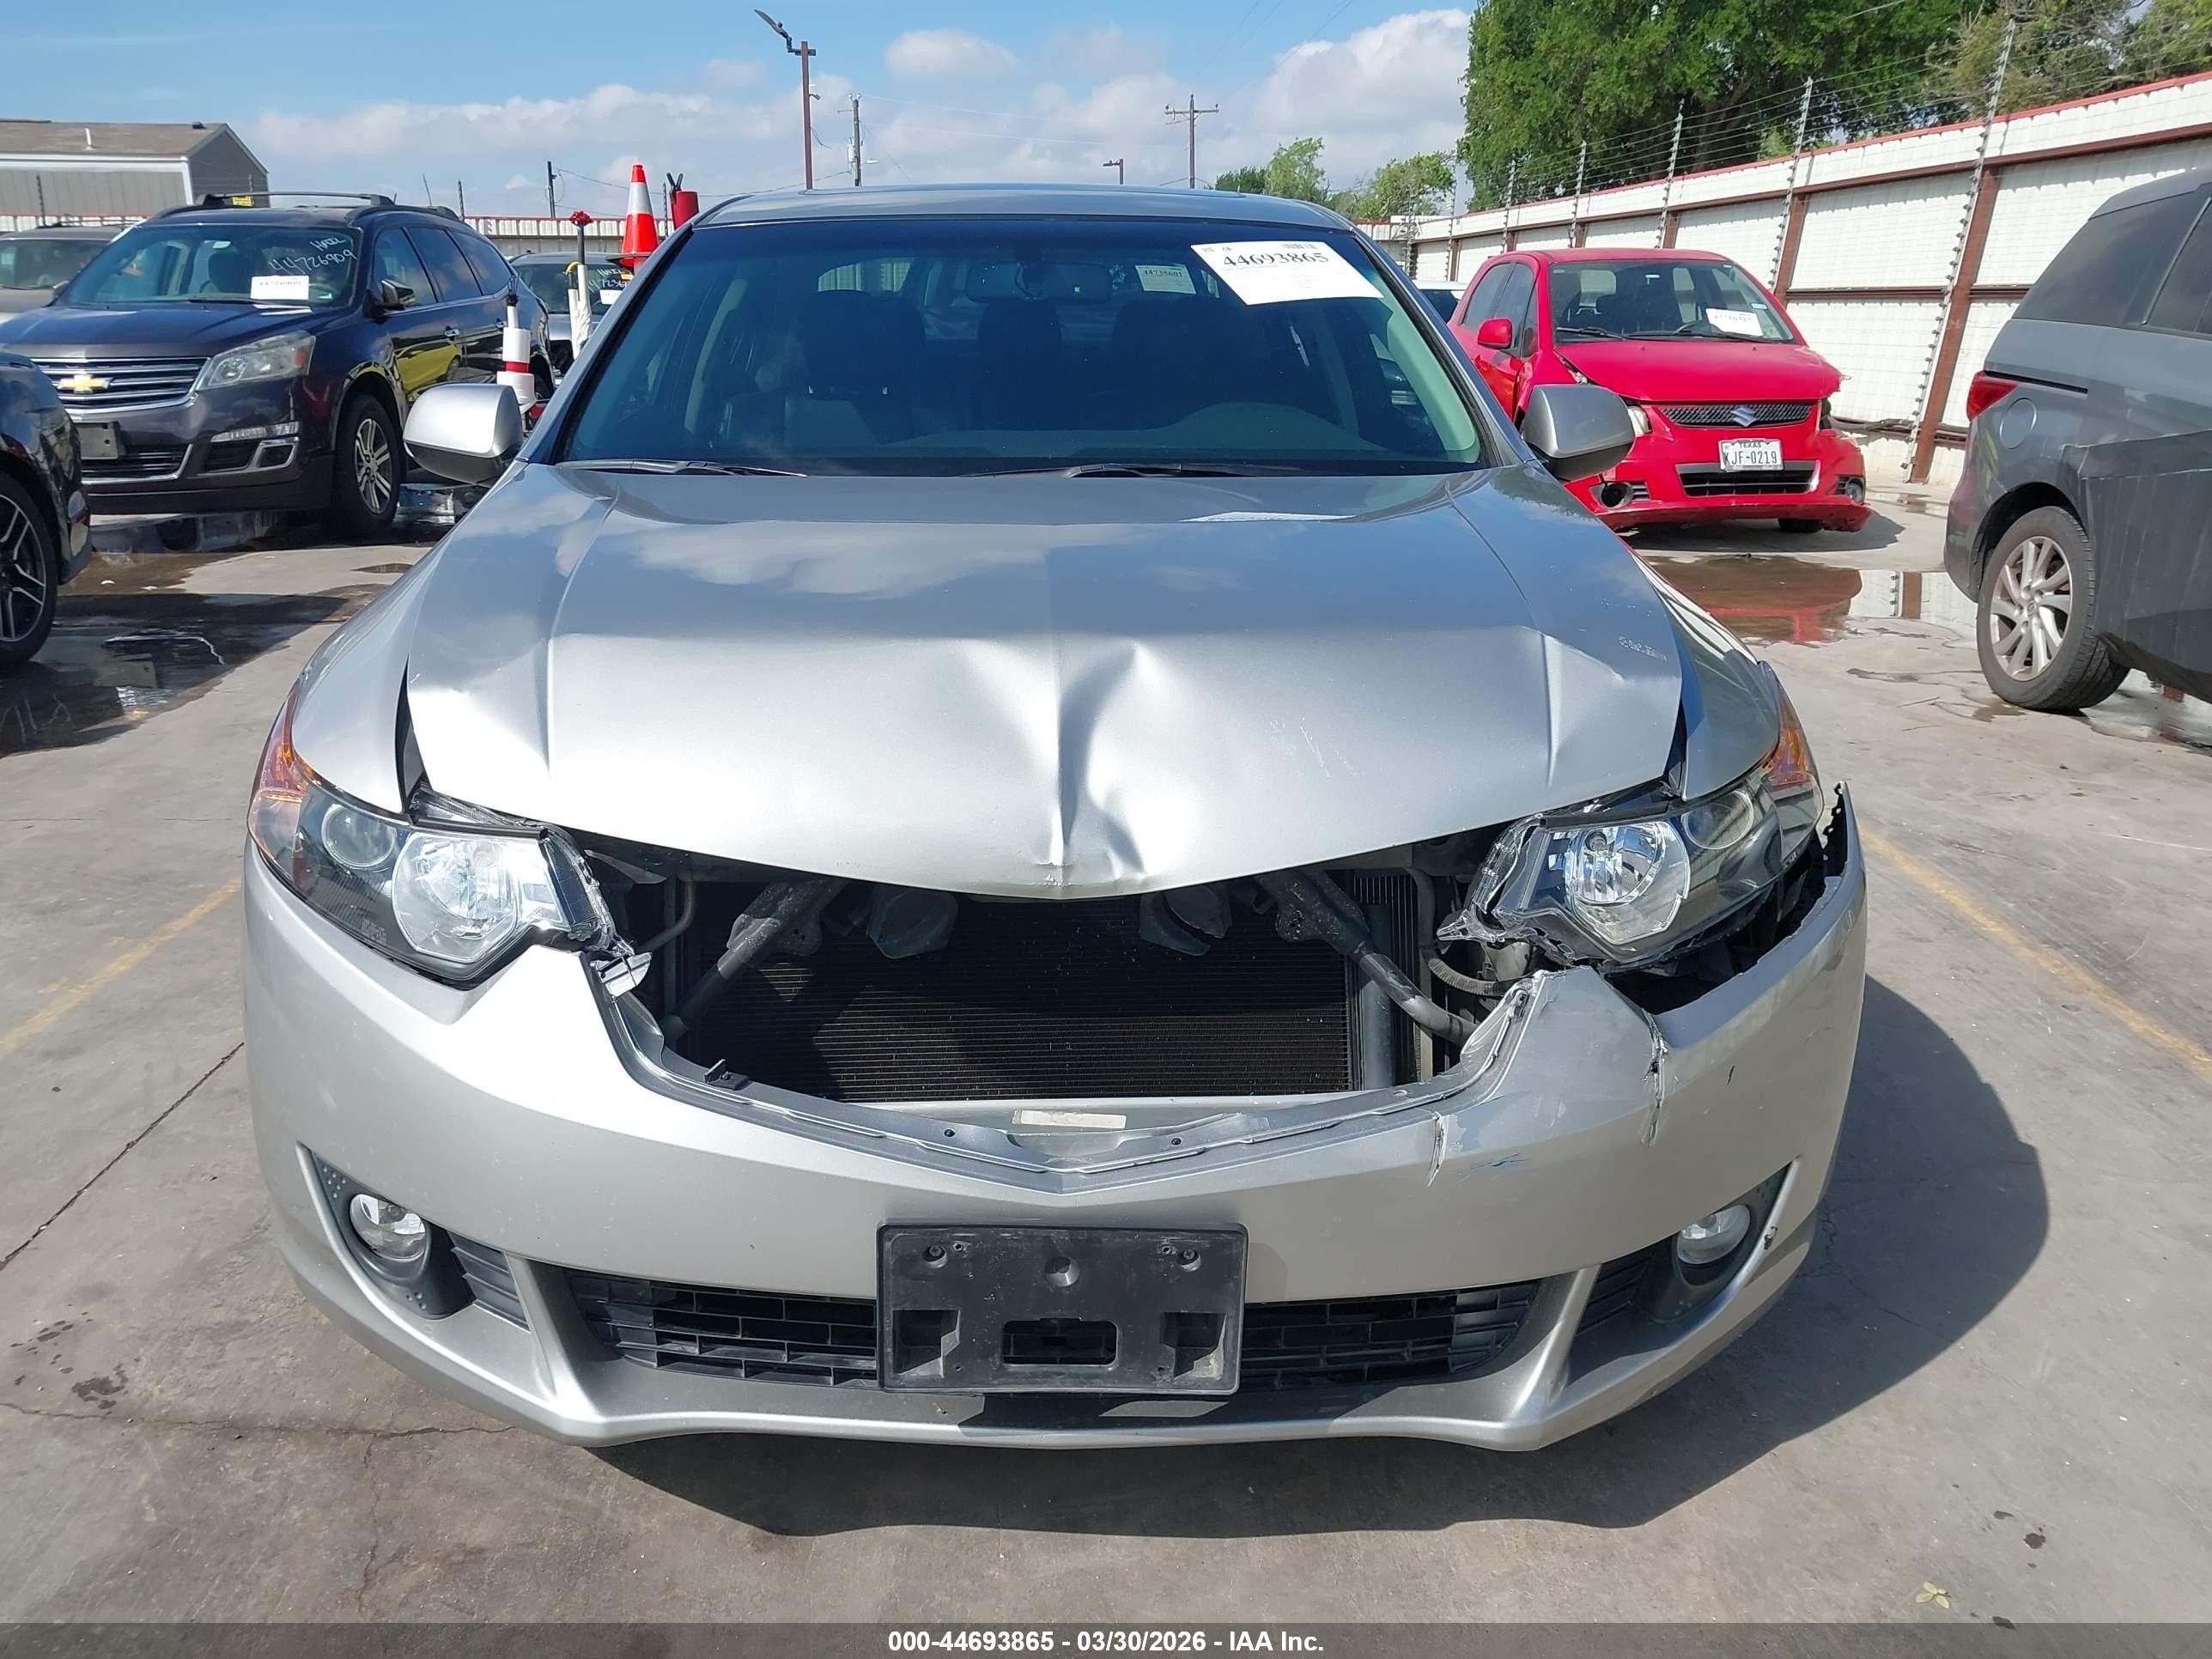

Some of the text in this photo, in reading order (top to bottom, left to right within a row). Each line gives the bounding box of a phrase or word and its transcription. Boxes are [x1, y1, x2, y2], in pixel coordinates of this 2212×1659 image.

[268, 249, 357, 275] 44726909
[1224, 252, 1328, 266] 44693865
[1723, 451, 1778, 465] KJF-0219
